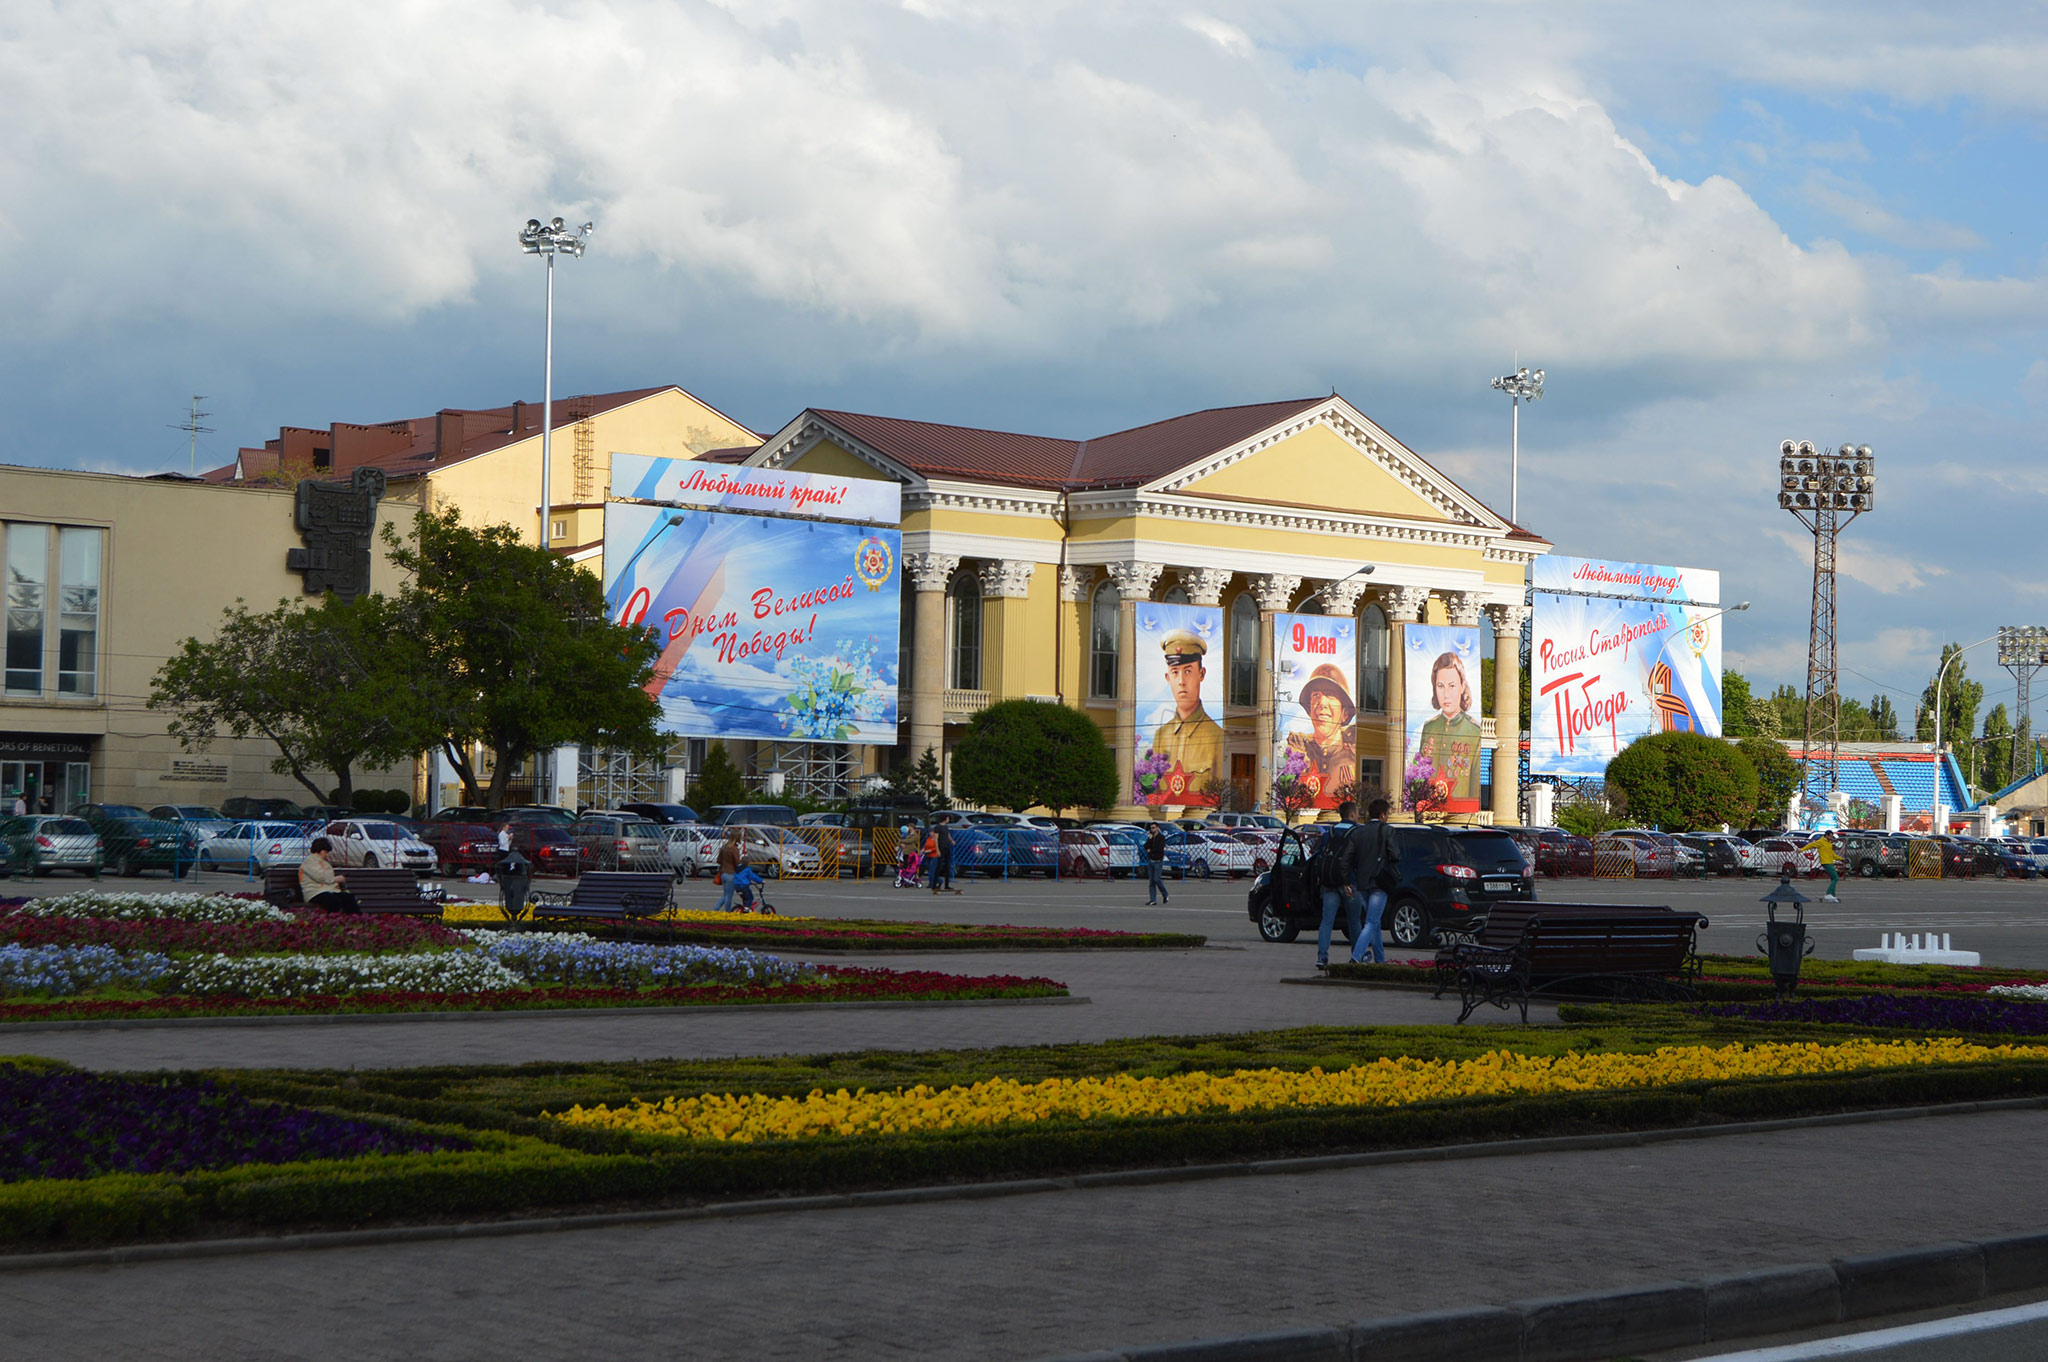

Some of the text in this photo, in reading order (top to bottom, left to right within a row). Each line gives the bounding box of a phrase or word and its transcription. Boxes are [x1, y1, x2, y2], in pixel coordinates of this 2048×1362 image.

[679, 469, 848, 508] Любимый край!
[1573, 562, 1682, 594] Любимый город!
[664, 606, 739, 641] Днем
[751, 574, 855, 620] Великой
[712, 613, 818, 665] Победы!
[1292, 622, 1336, 654] 9 мая
[1540, 612, 1669, 674] Россия. Ставрополь.
[1540, 671, 1634, 759] Победа.
[18, 742, 30, 752] OF
